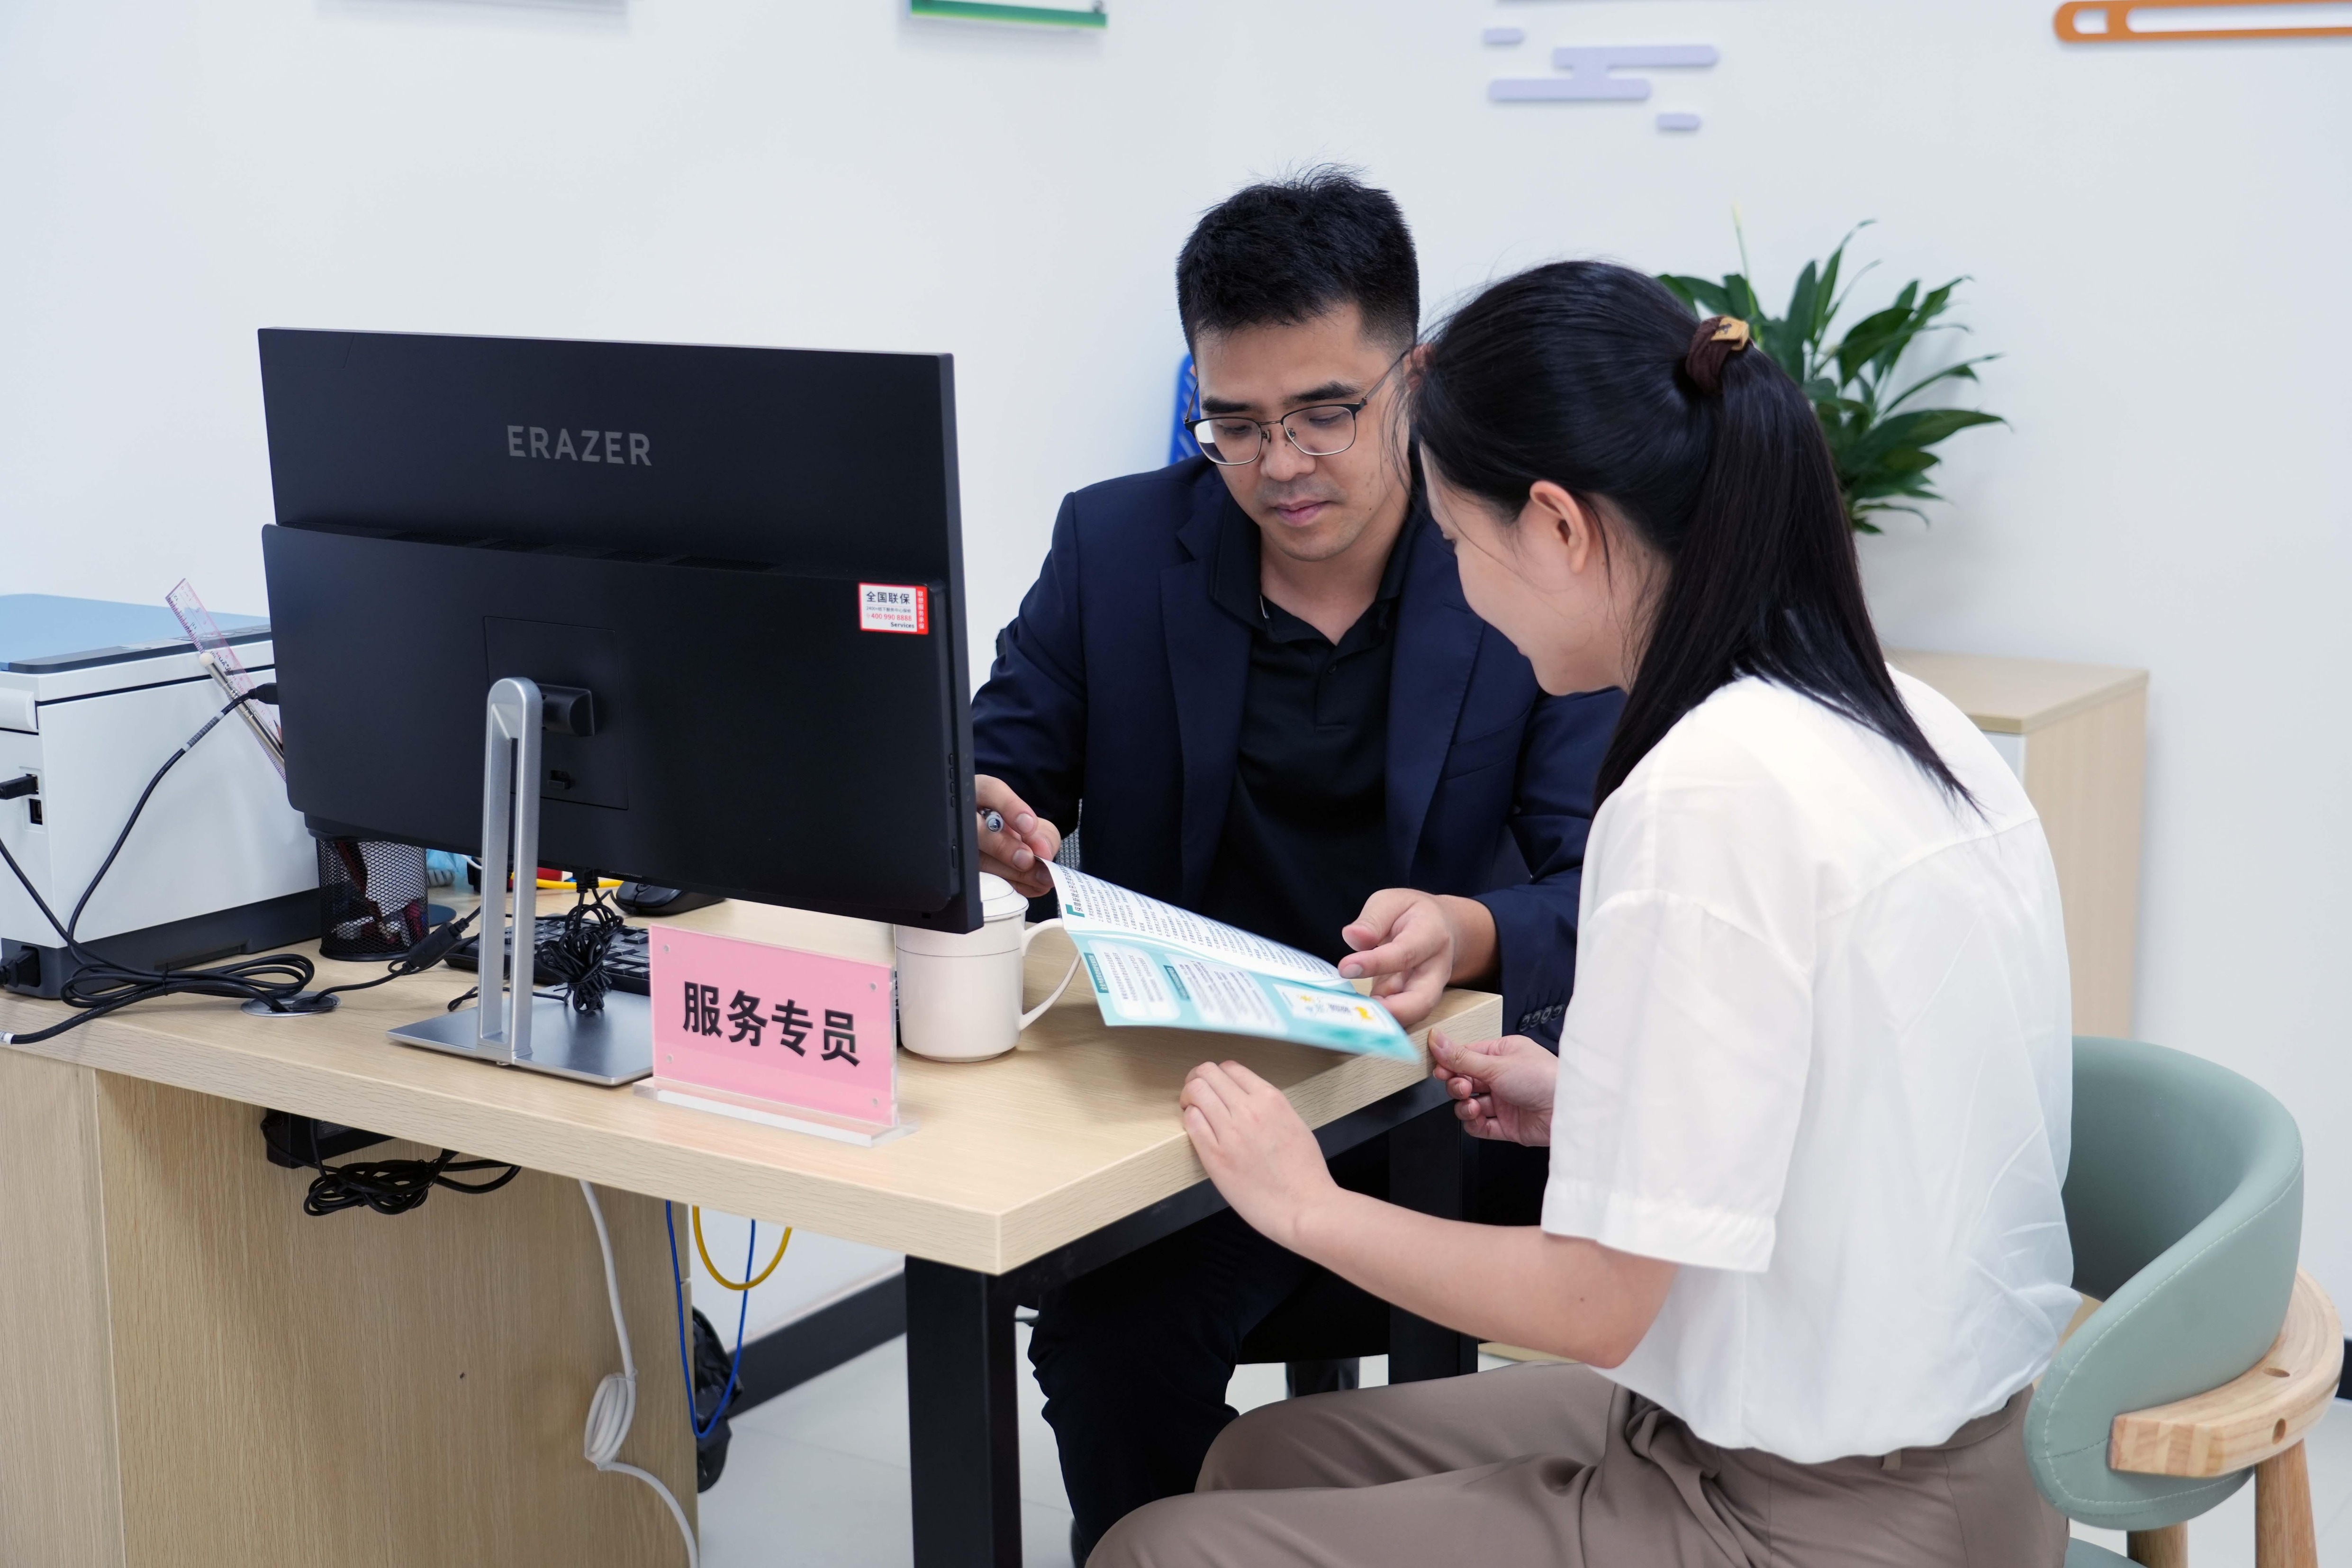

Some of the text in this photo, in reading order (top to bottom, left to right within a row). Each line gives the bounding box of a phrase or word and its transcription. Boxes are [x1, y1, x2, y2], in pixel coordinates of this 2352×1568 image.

[507, 425, 652, 466] ERAZER
[866, 591, 911, 604] 全国联保
[682, 980, 860, 1067] 服务专员
